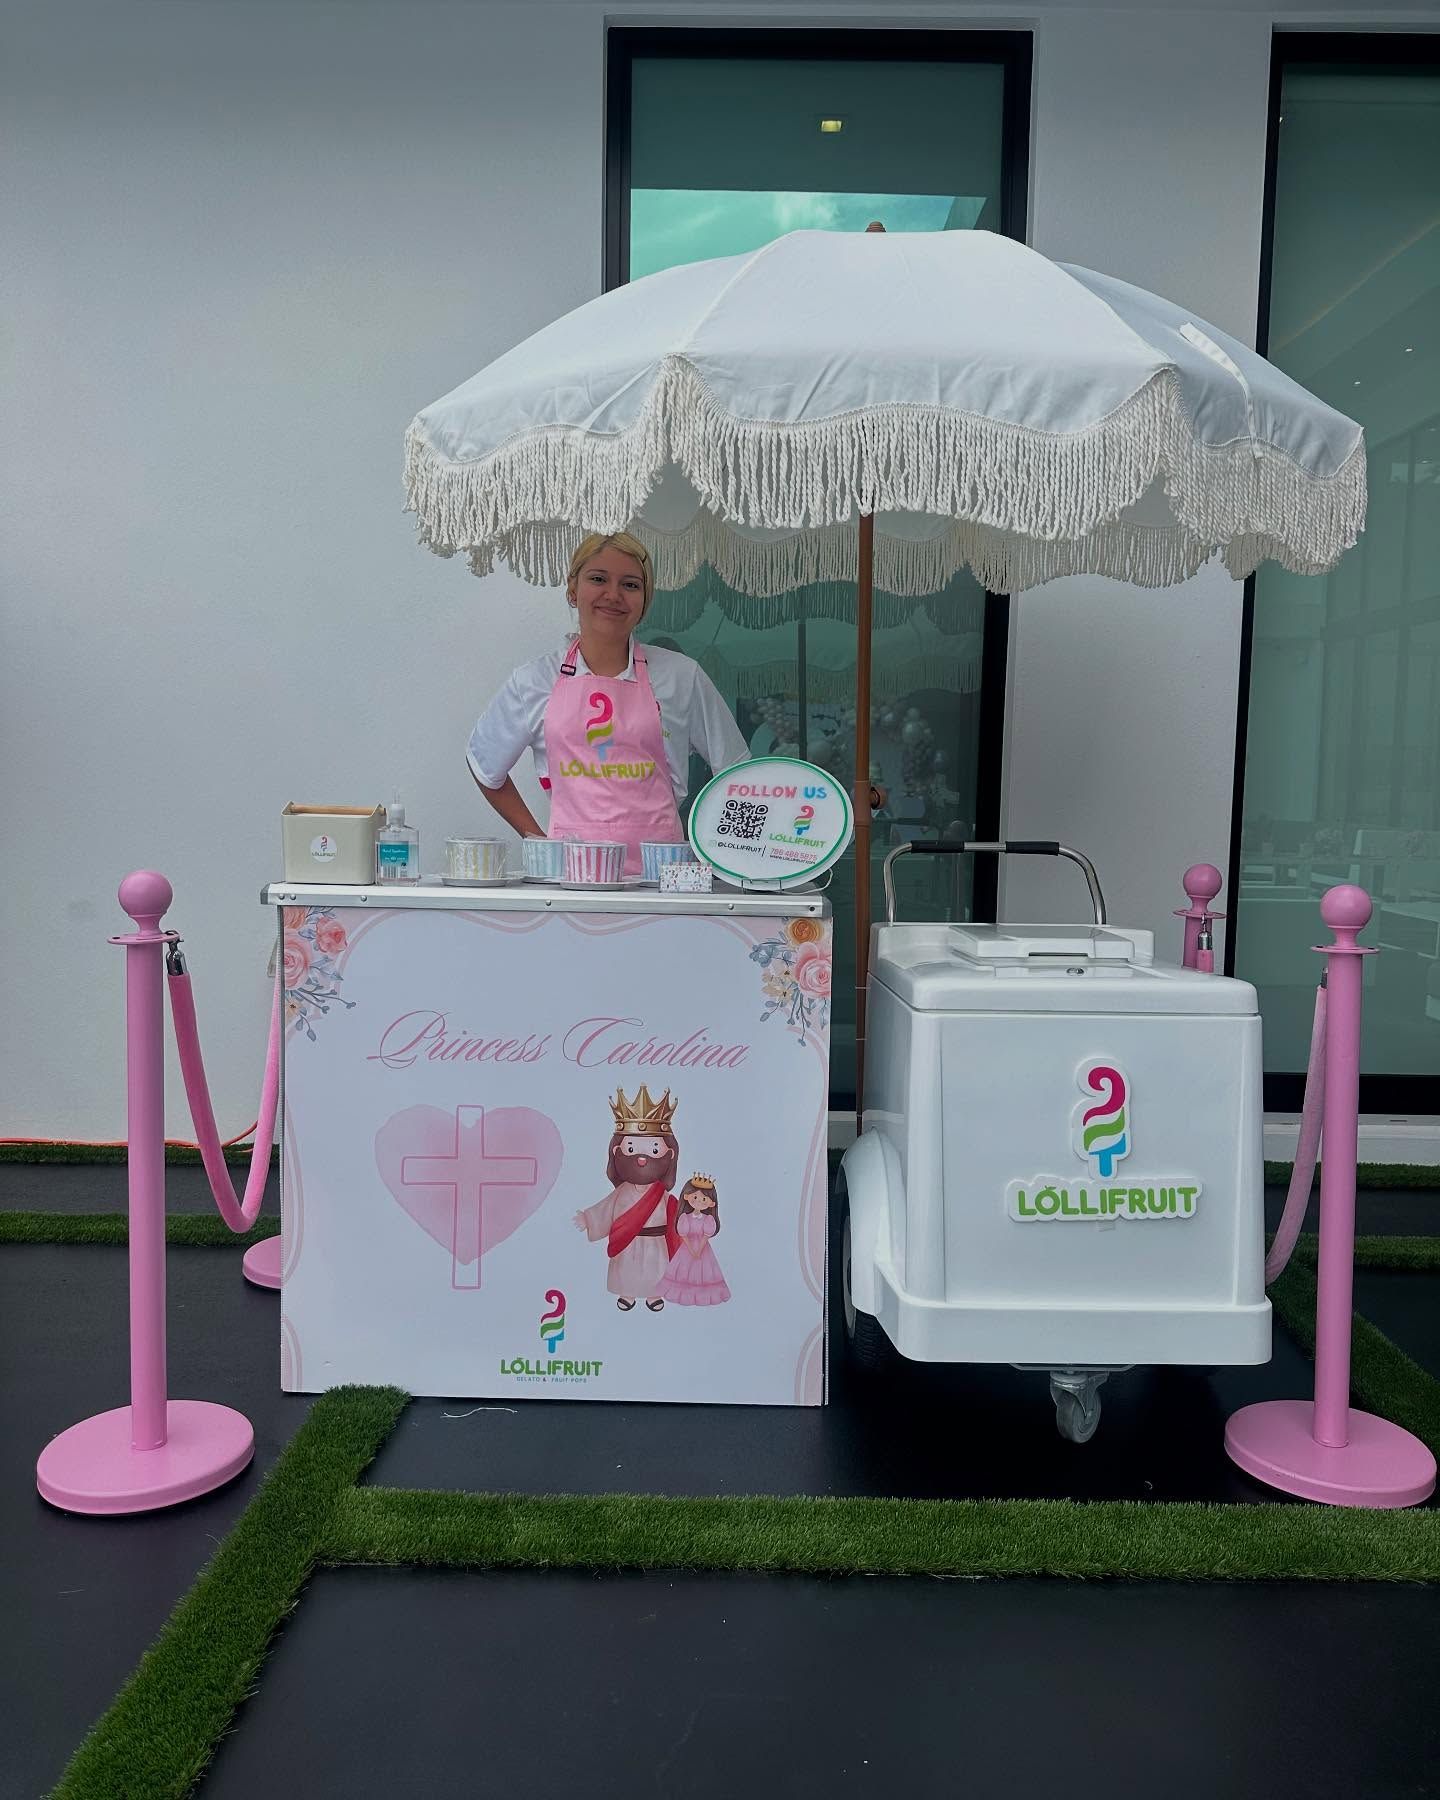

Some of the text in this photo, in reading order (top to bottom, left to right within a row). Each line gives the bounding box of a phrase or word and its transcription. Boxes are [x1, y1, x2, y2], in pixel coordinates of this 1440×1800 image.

[727, 784, 828, 800] FOLLOW US
[366, 1010, 751, 1070] Princess Carolina
